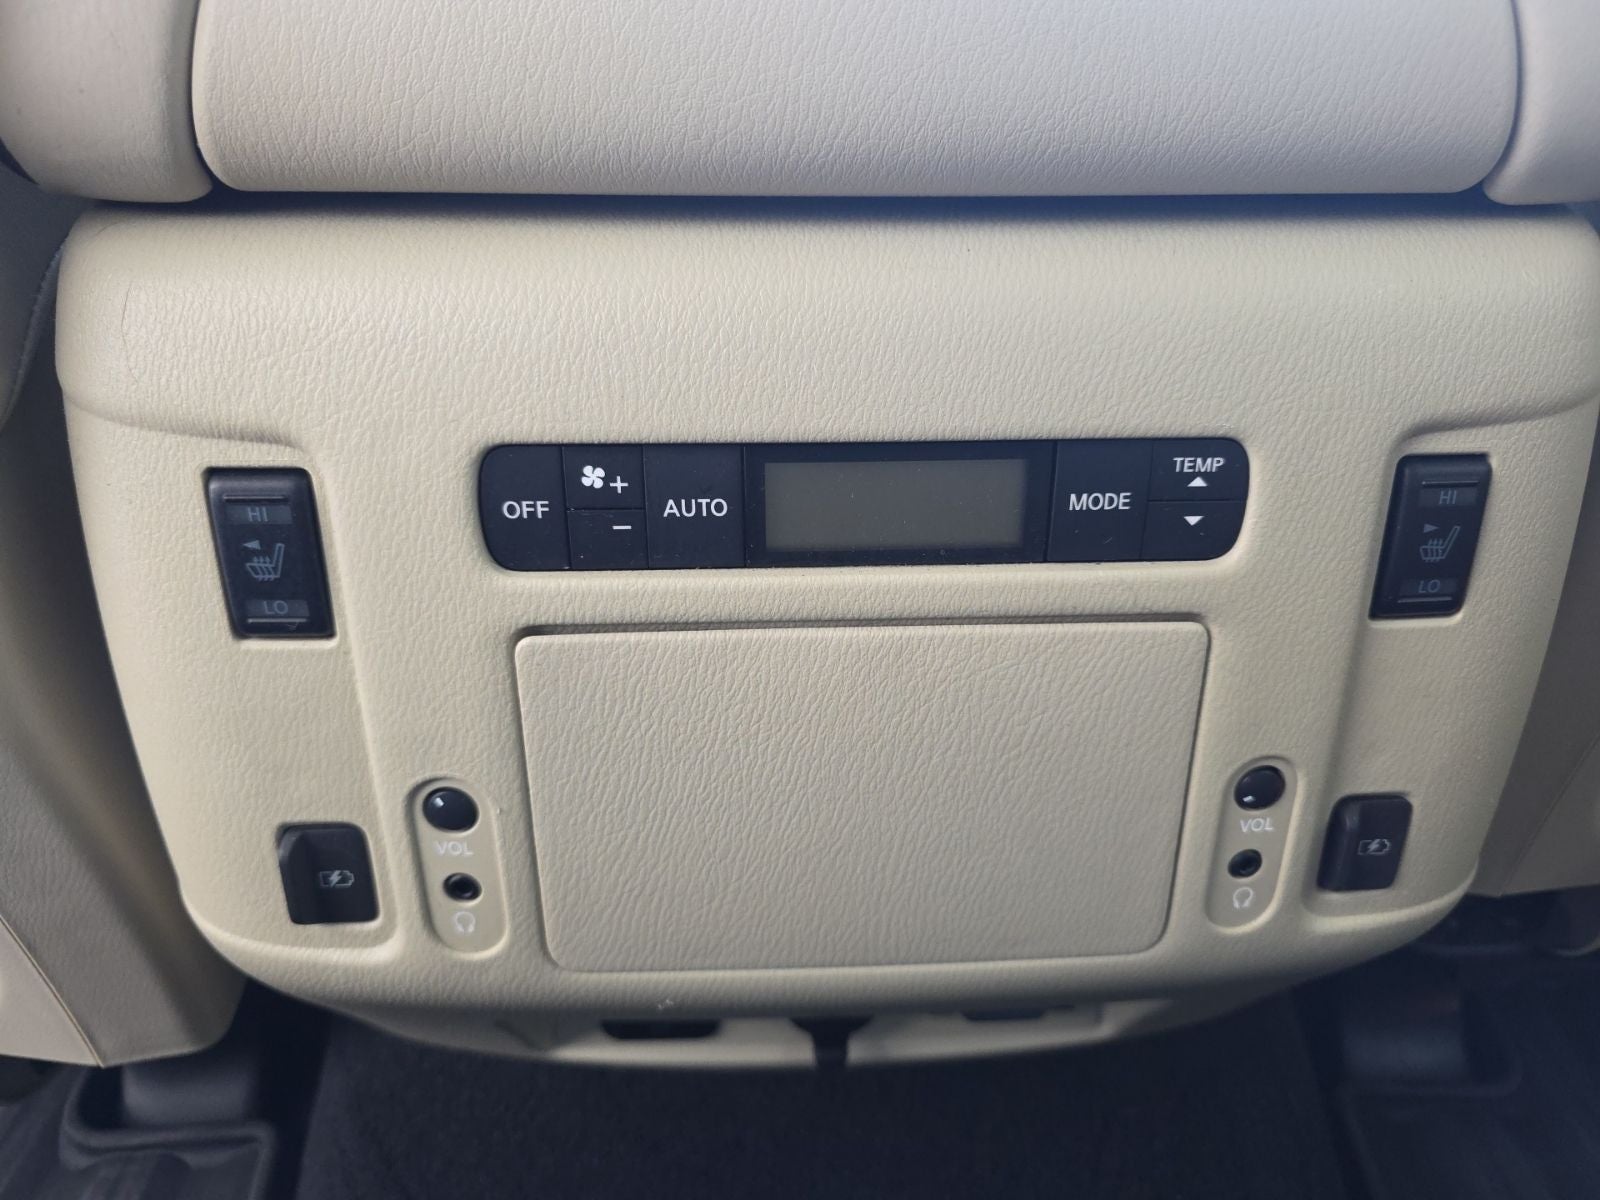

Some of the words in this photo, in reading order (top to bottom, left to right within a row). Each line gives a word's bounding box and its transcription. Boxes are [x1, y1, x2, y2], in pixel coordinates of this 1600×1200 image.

[1173, 457, 1225, 473] TEMP
[1069, 492, 1132, 511] MODE
[1438, 489, 1458, 505] HI
[247, 506, 269, 523] HI
[502, 501, 550, 519] OFF
[663, 498, 728, 518] AUTO
[1418, 579, 1441, 594] LO
[263, 600, 289, 615] LO
[1239, 817, 1274, 833] VOL
[435, 840, 474, 857] VOL
